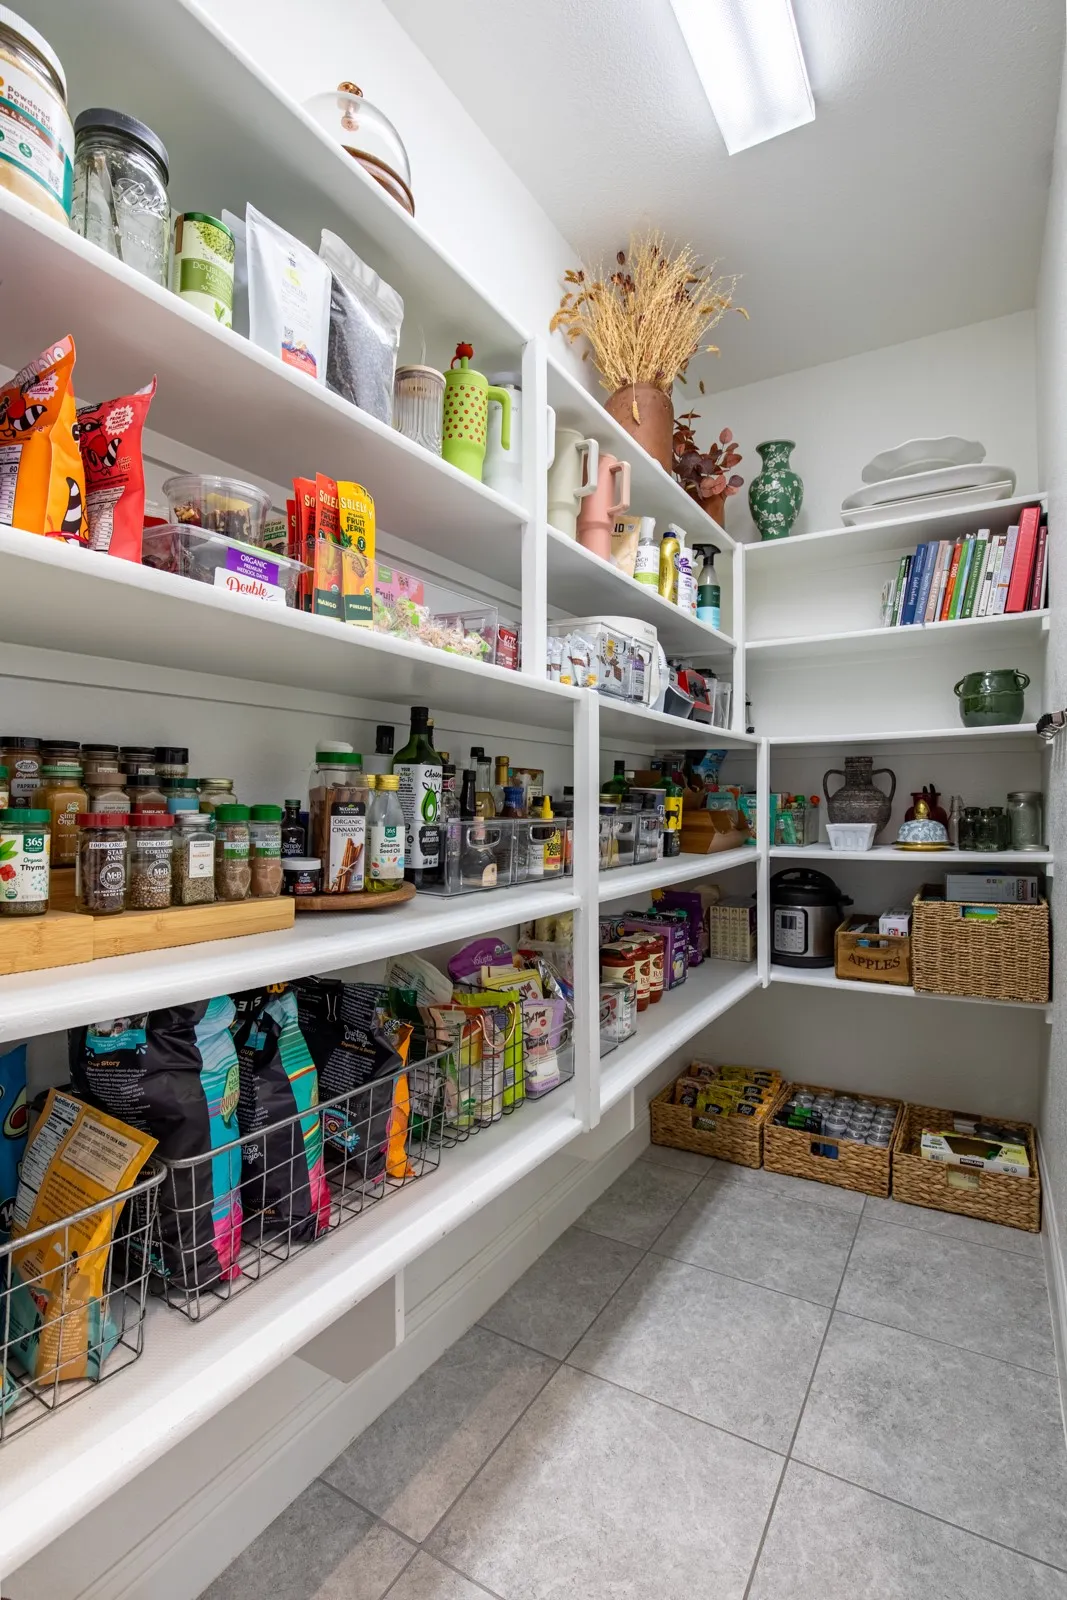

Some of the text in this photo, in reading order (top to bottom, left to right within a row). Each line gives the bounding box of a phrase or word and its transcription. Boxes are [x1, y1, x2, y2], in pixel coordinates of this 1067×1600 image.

[7, 85, 51, 122] Powdered
[7, 93, 39, 119] Peanut
[117, 178, 168, 214] Ball
[10, 465, 17, 473] 60
[340, 497, 367, 513] SOLELY
[321, 511, 338, 522] FRUIT
[346, 516, 365, 527] FRUIT
[320, 518, 338, 530] JERKY
[345, 524, 366, 536] JERKY
[240, 554, 267, 569] ORGANIC
[243, 563, 263, 573] PREMIUM
[237, 566, 269, 582] MEDJOOL DATES
[226, 576, 268, 597] Double
[922, 572, 930, 590] healthy
[375, 588, 392, 601] Fruit
[318, 599, 336, 609] MANGO
[349, 603, 371, 613] PINEAPPLE
[25, 837, 43, 847] 365
[20, 864, 45, 872] Thyme
[849, 953, 901, 971] APPLES
[341, 1042, 359, 1051] Together
[364, 1047, 376, 1055] Better
[55, 1096, 80, 1112] Nutrition Facts
[961, 1159, 984, 1167] KIRKLAND
